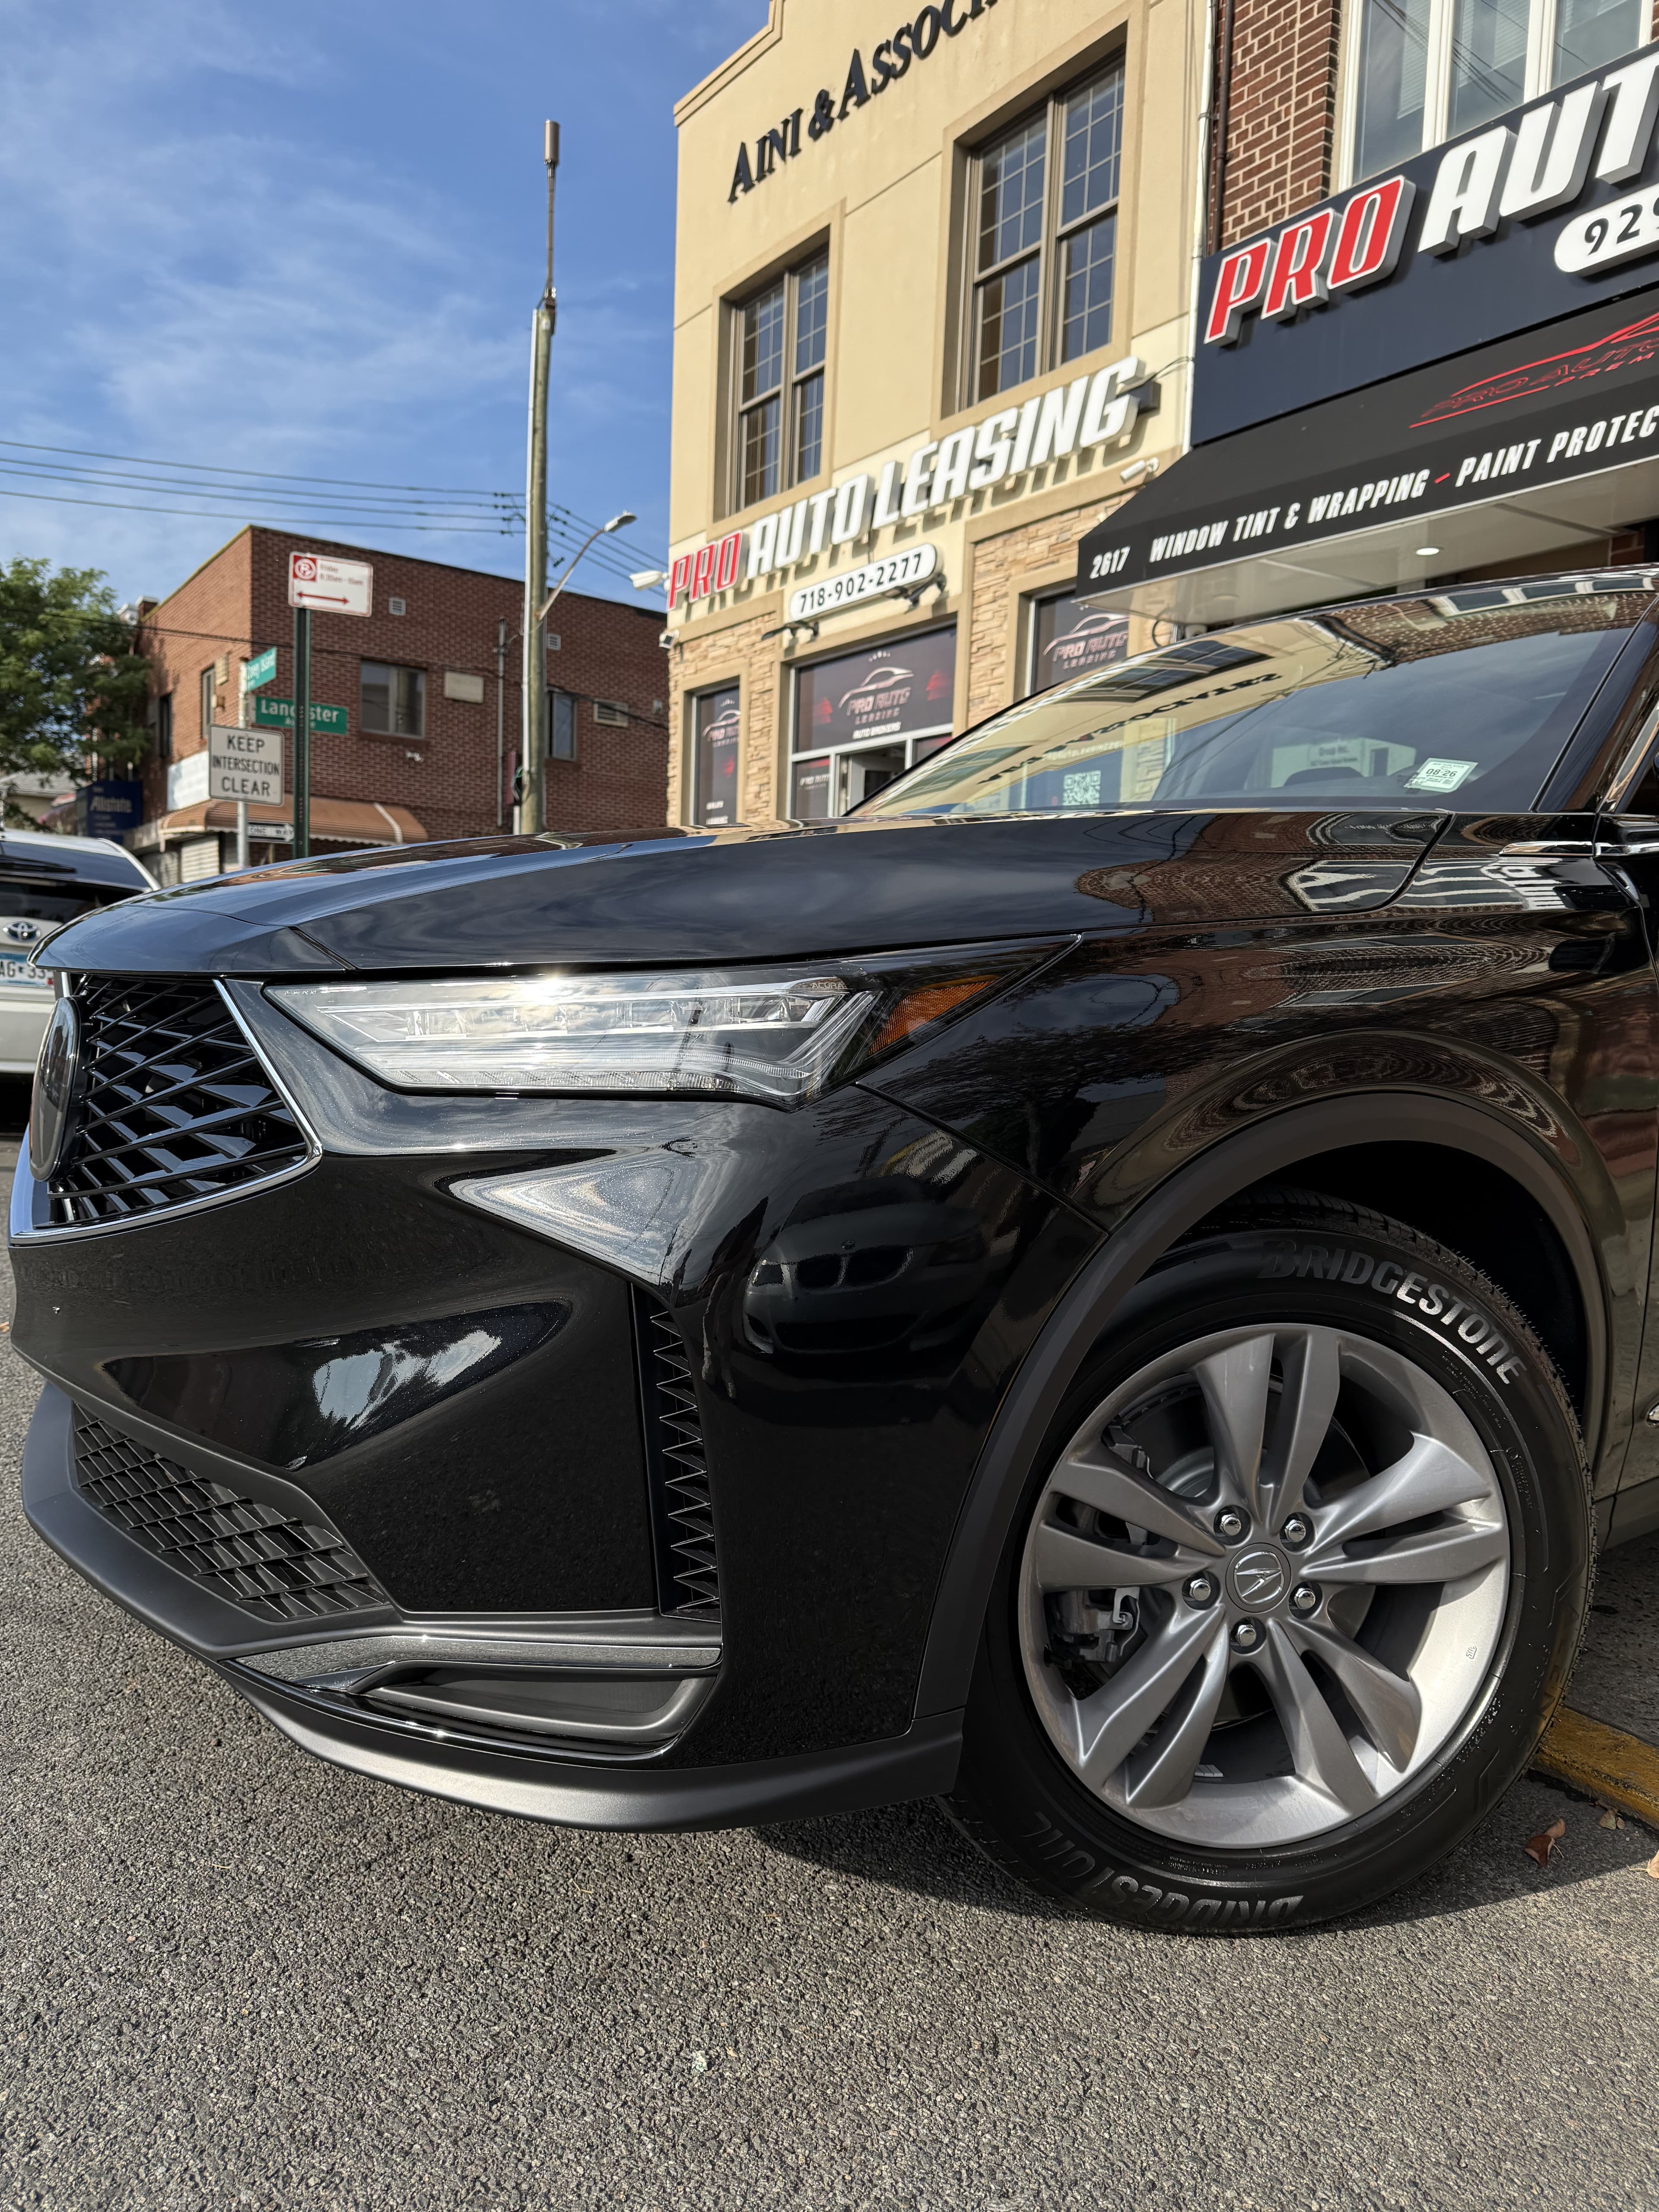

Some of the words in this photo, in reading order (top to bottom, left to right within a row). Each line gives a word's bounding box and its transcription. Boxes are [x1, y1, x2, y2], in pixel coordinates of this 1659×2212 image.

[728, 108, 803, 204] AINI
[808, 89, 835, 142] &
[837, 0, 993, 122] ASSOC
[1584, 196, 1659, 256] 92
[1204, 175, 1409, 345] PRO
[667, 530, 744, 610] PRO
[747, 474, 870, 579] AUTO
[872, 356, 1139, 530] LEASING
[1089, 546, 1131, 579] 2617
[1149, 519, 1230, 563] WINDOW
[1232, 506, 1281, 542] TINT
[1284, 502, 1301, 529] &
[1307, 469, 1430, 524] WRAPPING
[1455, 438, 1541, 487] PAINT
[1546, 405, 1659, 463] PROTEC
[800, 554, 922, 613] 718-902-2277
[1052, 639, 1086, 662] PRO
[261, 699, 340, 723] Lancster
[846, 695, 874, 716] PRO
[212, 754, 280, 775] INTERSECTION
[227, 734, 265, 753] KEEP
[221, 775, 270, 797] CLEAR
[1257, 1239, 1528, 1384] BRIDGESTONE
